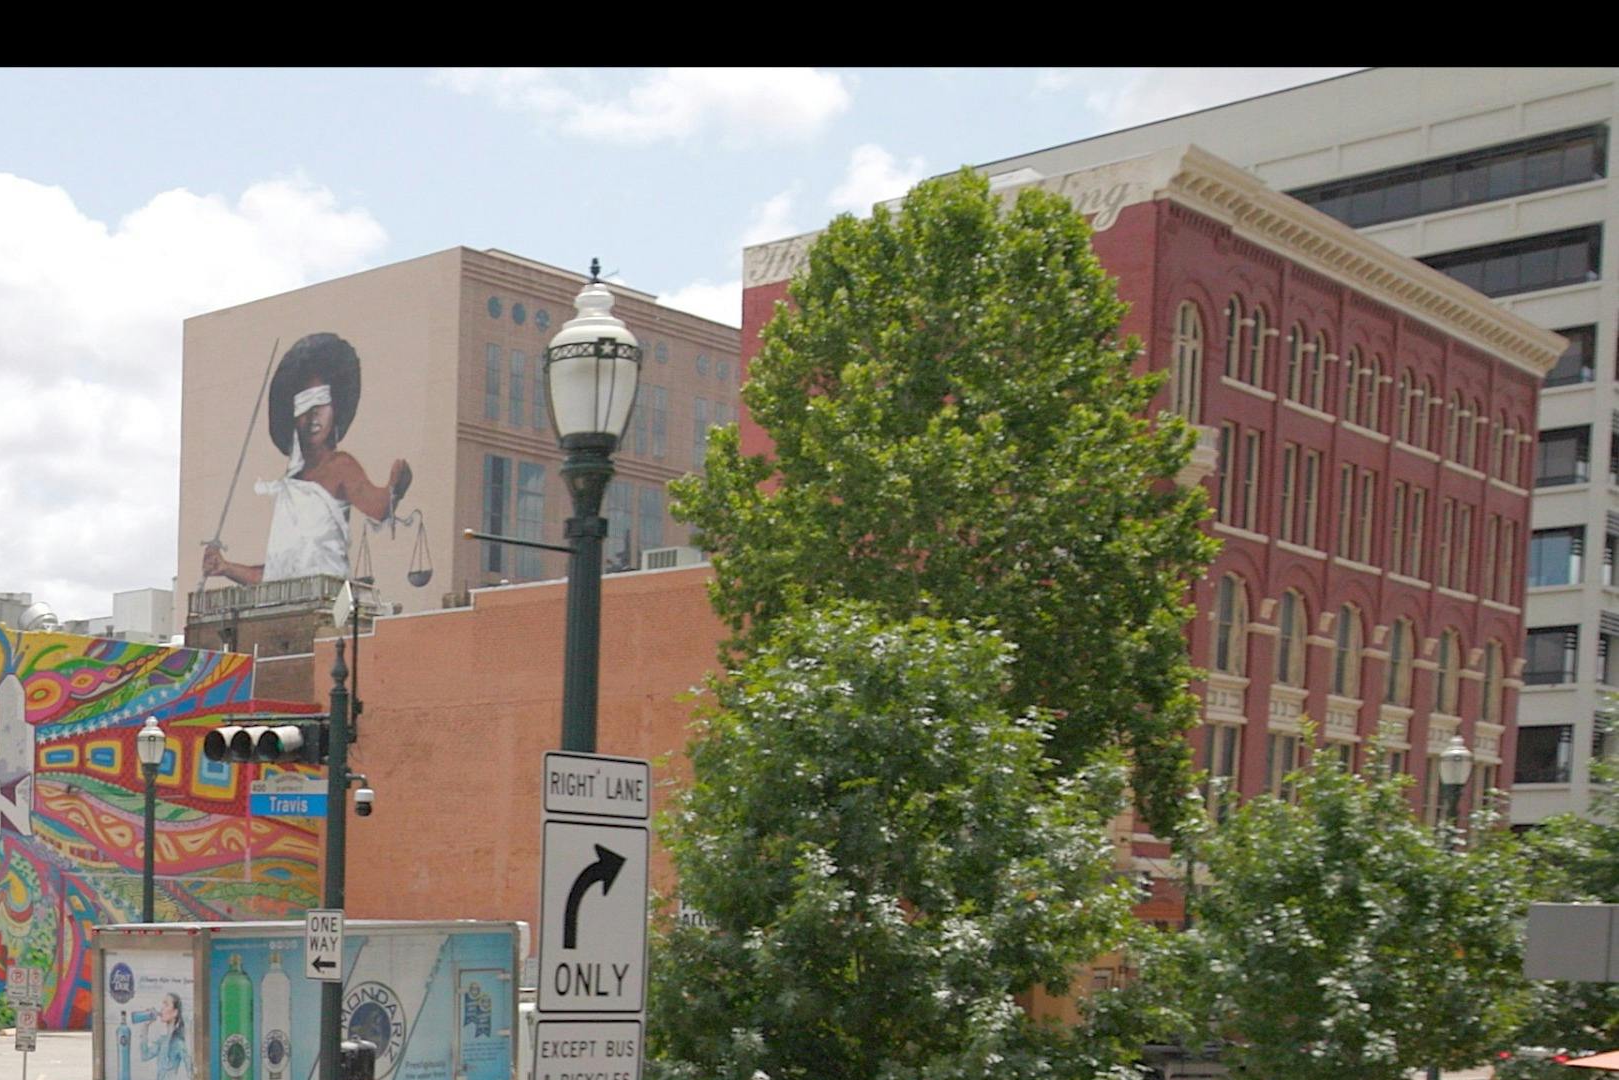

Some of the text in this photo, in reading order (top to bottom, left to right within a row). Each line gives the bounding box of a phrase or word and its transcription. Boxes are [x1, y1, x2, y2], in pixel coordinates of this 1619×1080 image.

[550, 771, 644, 801] RIGHT LANE
[269, 795, 309, 813] Travis
[311, 916, 338, 932] ONE
[310, 936, 339, 952] WAY
[554, 961, 630, 997] ONLY
[541, 1039, 636, 1059] EXCEPT BUS
